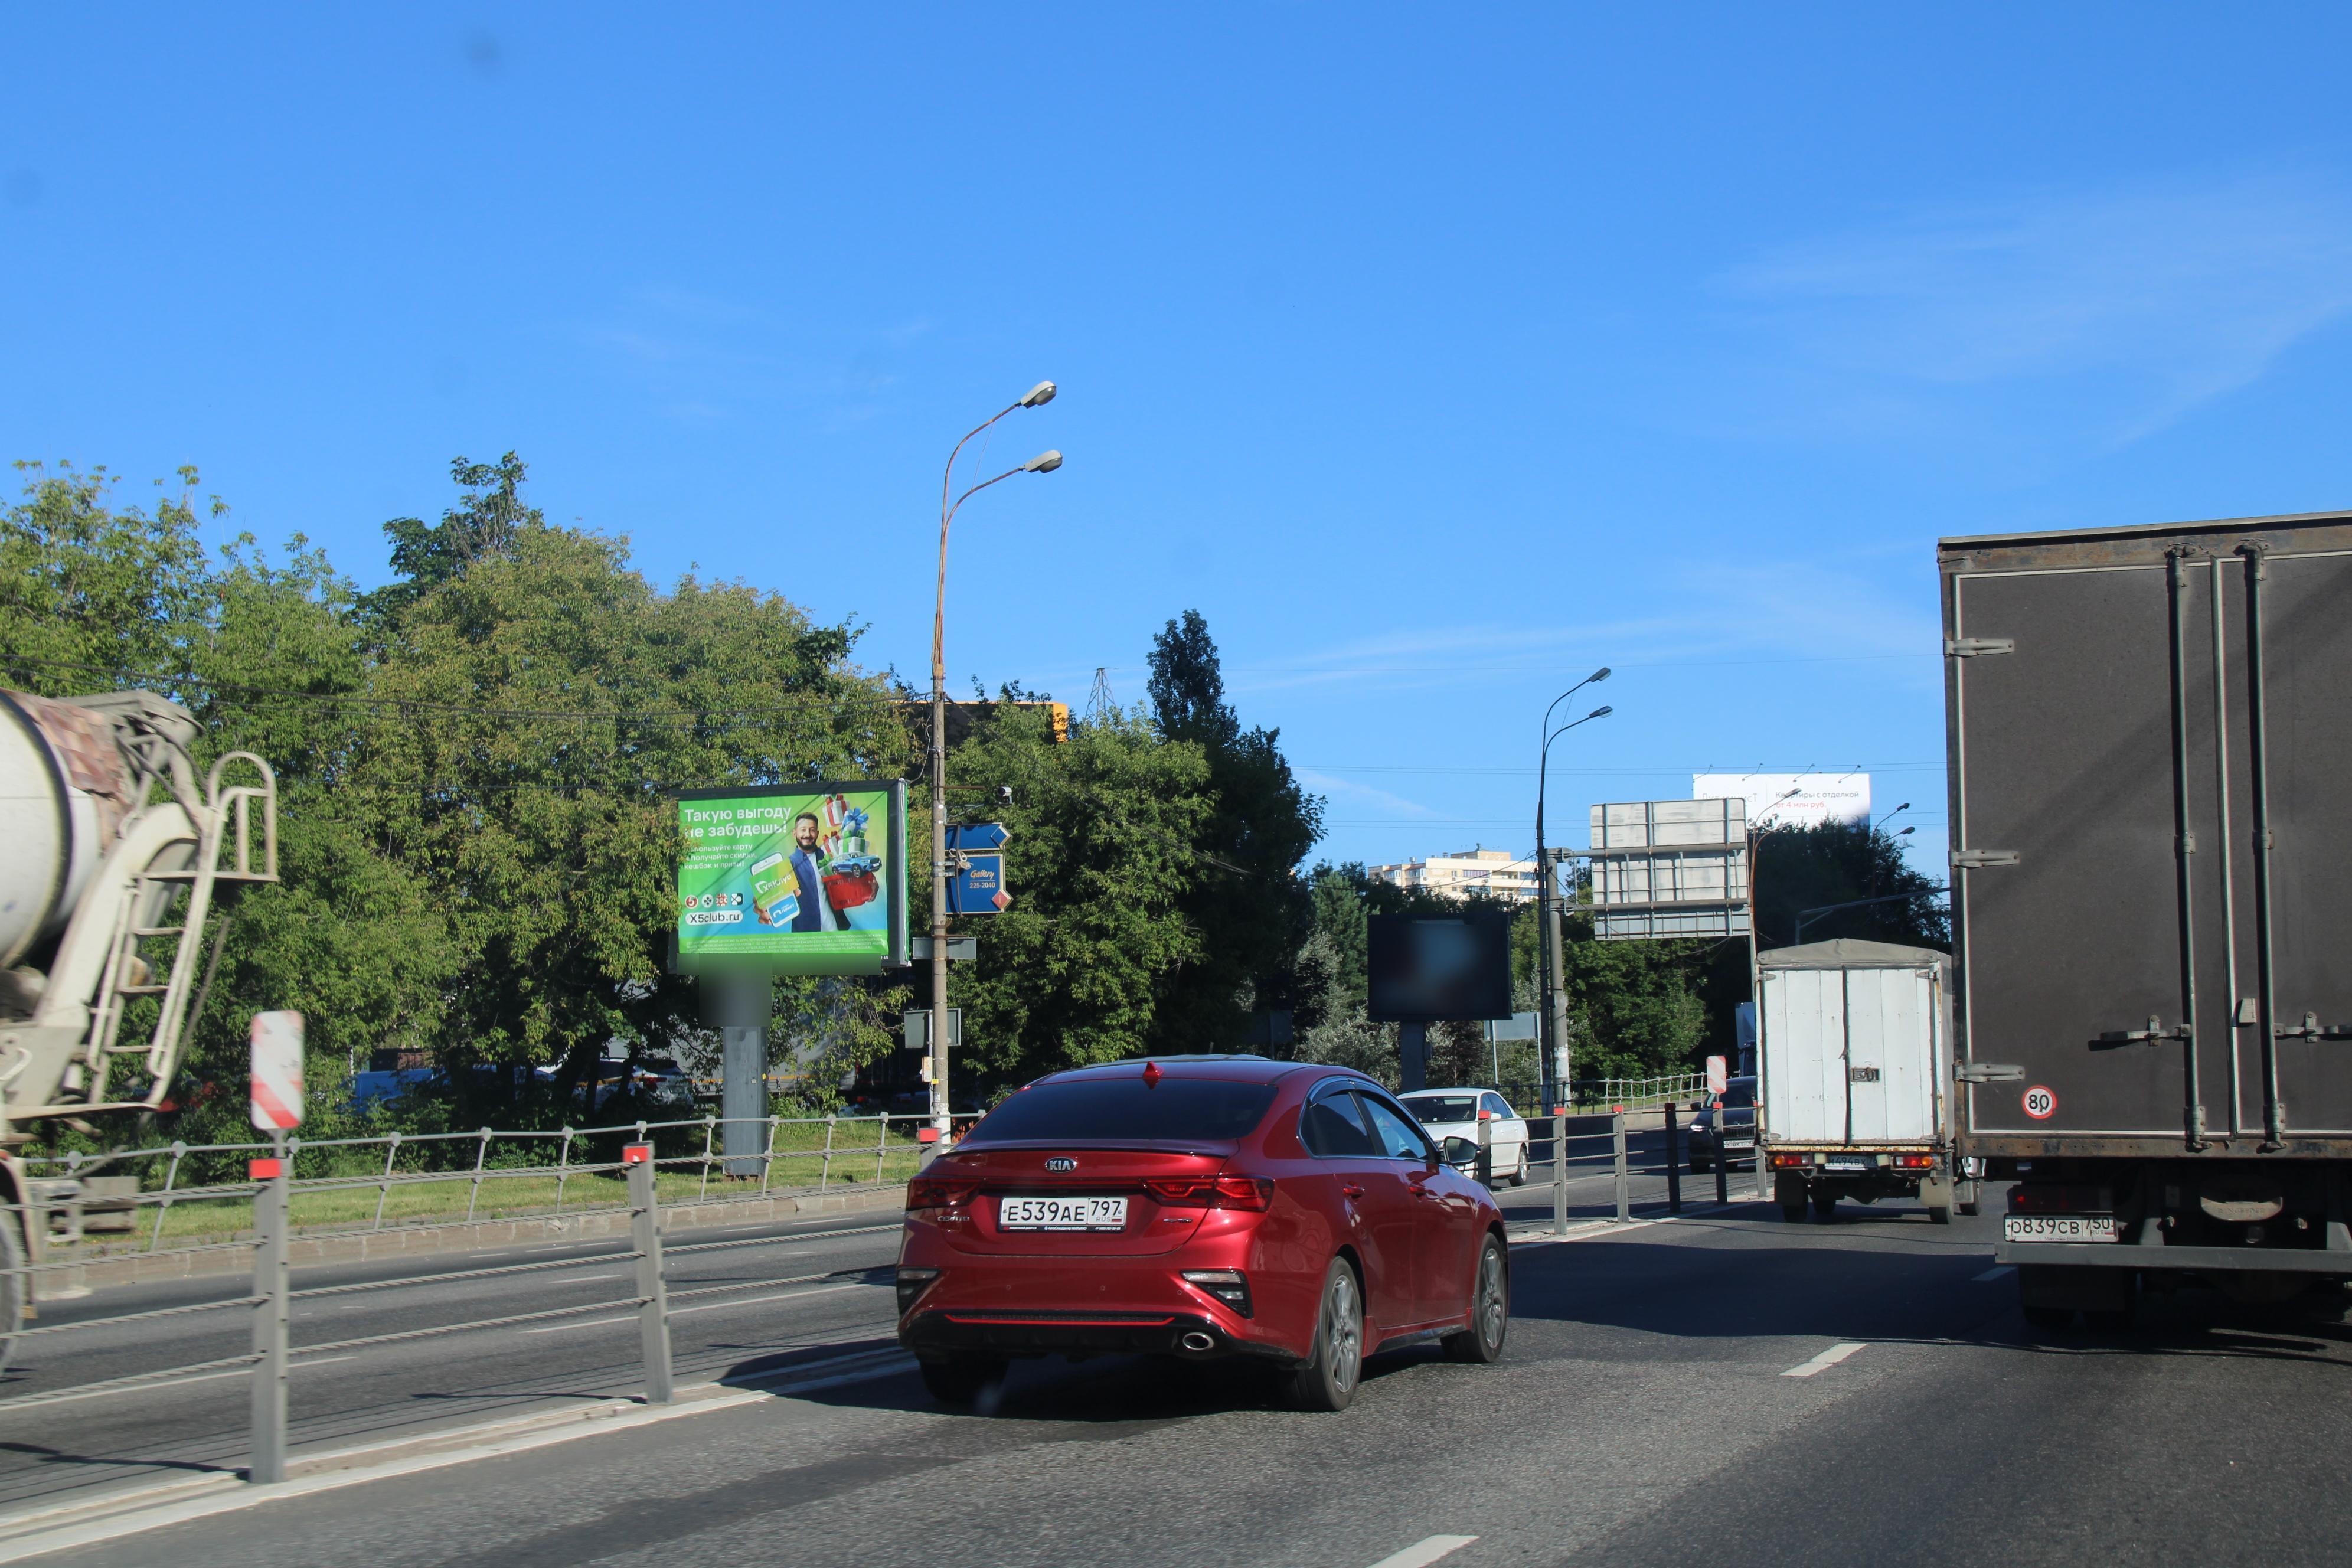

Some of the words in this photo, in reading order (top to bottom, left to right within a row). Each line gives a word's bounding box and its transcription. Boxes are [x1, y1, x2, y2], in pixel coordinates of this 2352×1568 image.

[1775, 791, 1815, 799] Квртиры
[684, 808, 732, 824] Такую
[737, 806, 792, 819] выгоду
[708, 821, 787, 838] забудешь!
[691, 853, 729, 863] получайте
[684, 861, 712, 870] кешбэк
[970, 869, 995, 880] Gallery
[690, 913, 740, 923] X5club.ru
[2028, 1094, 2049, 1110] 80
[1049, 1160, 1071, 1170] KIA
[1091, 1200, 1121, 1216] 797
[2083, 1217, 2110, 1229] 750
